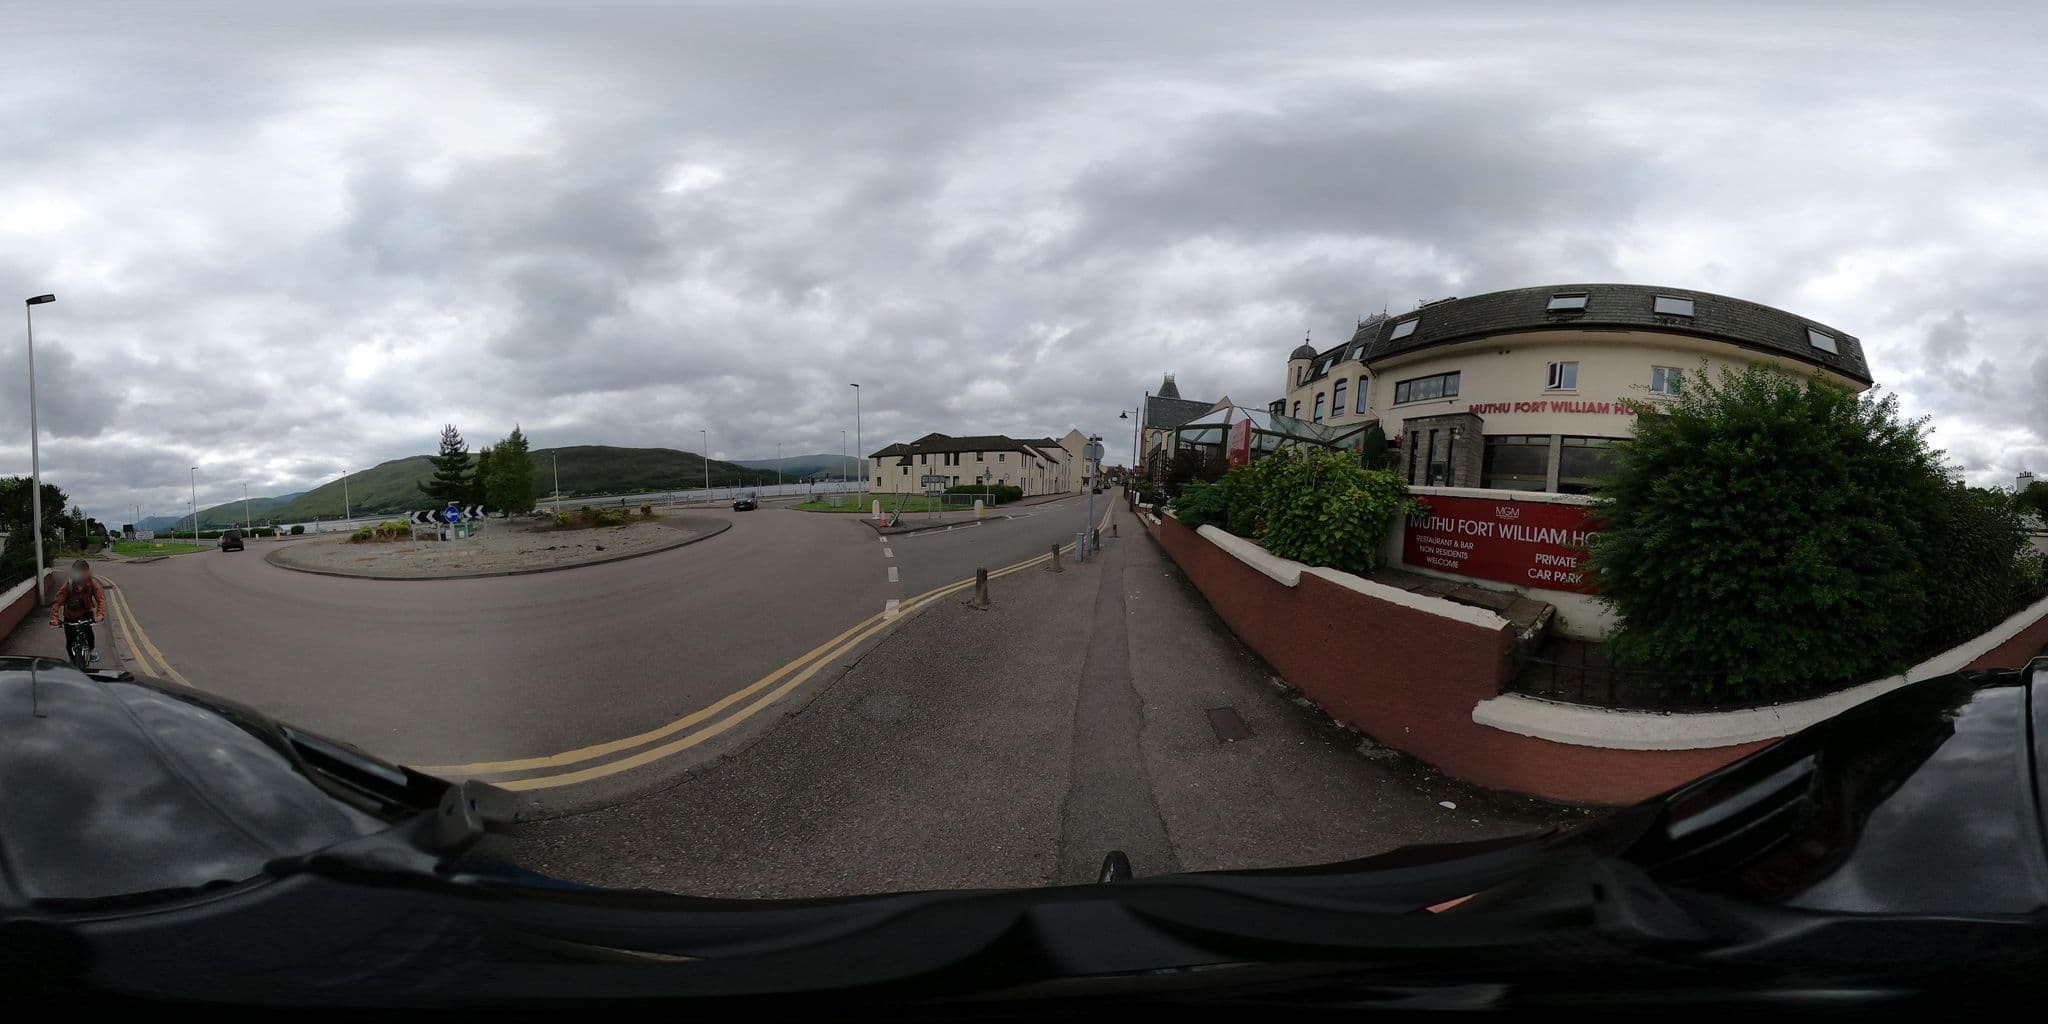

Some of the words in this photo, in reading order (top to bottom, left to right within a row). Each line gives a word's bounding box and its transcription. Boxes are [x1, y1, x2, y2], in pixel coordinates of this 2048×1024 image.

[1469, 402, 1510, 414] MUTHU
[1514, 401, 1547, 413] FORT
[1551, 401, 1609, 414] WILLIAM
[1496, 506, 1519, 515] MGM
[1410, 513, 1454, 532] MUTHU
[1458, 519, 1494, 537] FORT
[1499, 523, 1567, 544] WILLIAM
[1416, 534, 1452, 547] RESTAURANT
[1453, 540, 1459, 548] &
[1460, 541, 1474, 550] BAR
[1419, 545, 1434, 554] NON
[1435, 548, 1468, 560] RESIDENTS
[1426, 556, 1459, 568] WELCOME
[1535, 553, 1577, 568] PRIVATE
[1527, 568, 1551, 580] CAR
[1554, 571, 1583, 584] PARK
